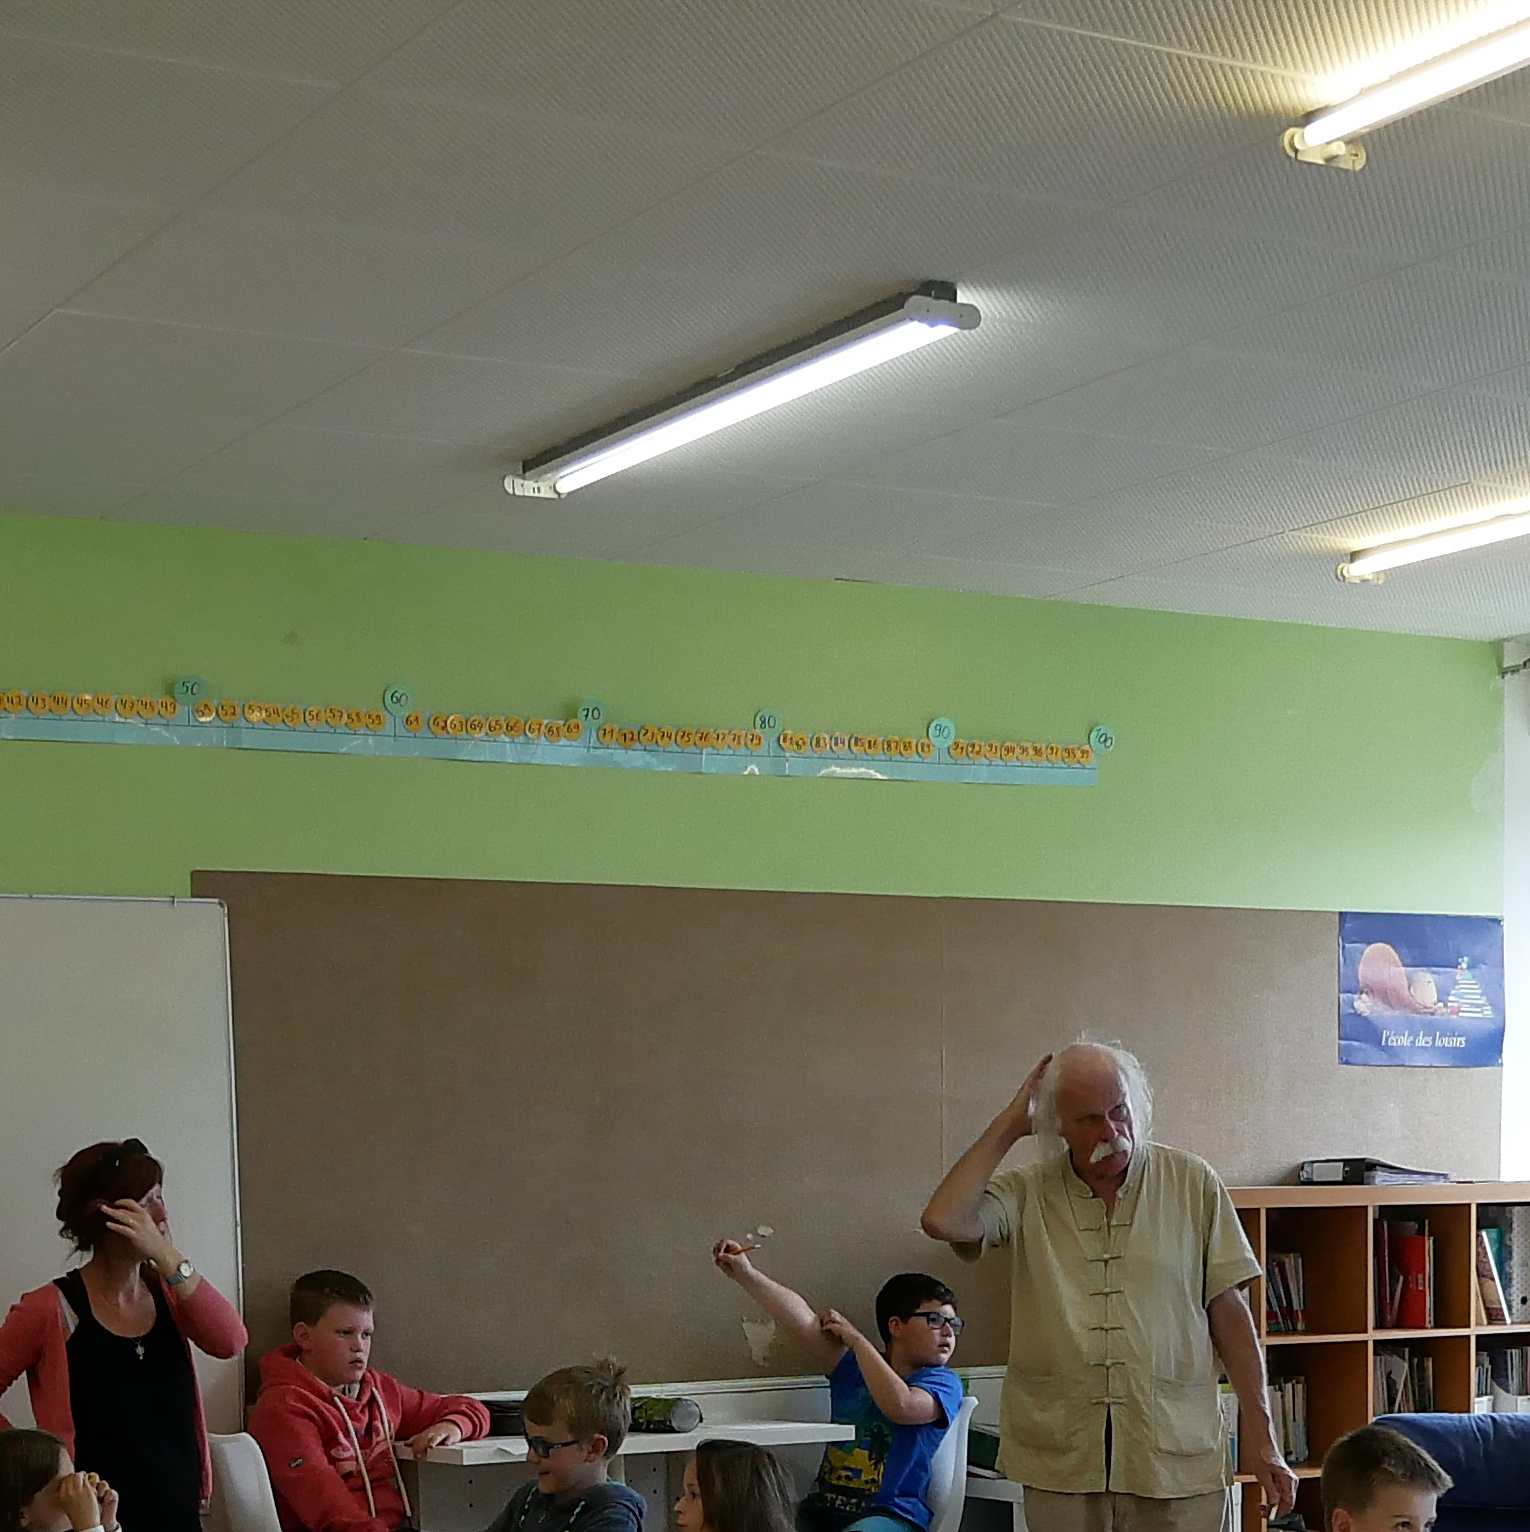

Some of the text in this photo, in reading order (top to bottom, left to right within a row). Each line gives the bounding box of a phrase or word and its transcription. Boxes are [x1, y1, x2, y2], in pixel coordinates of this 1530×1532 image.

[32, 696, 46, 708] 43
[53, 696, 68, 708] 44
[77, 697, 90, 708] 45
[120, 699, 134, 711] 47
[141, 700, 154, 712] 48
[161, 701, 176, 714] 49
[181, 681, 199, 695] 50
[391, 690, 409, 706] 60
[582, 707, 600, 721] 70
[760, 716, 776, 730] 80
[934, 724, 950, 740] 90
[1095, 728, 1113, 749] 100
[1381, 1029, 1467, 1048] l'école des loisirs
